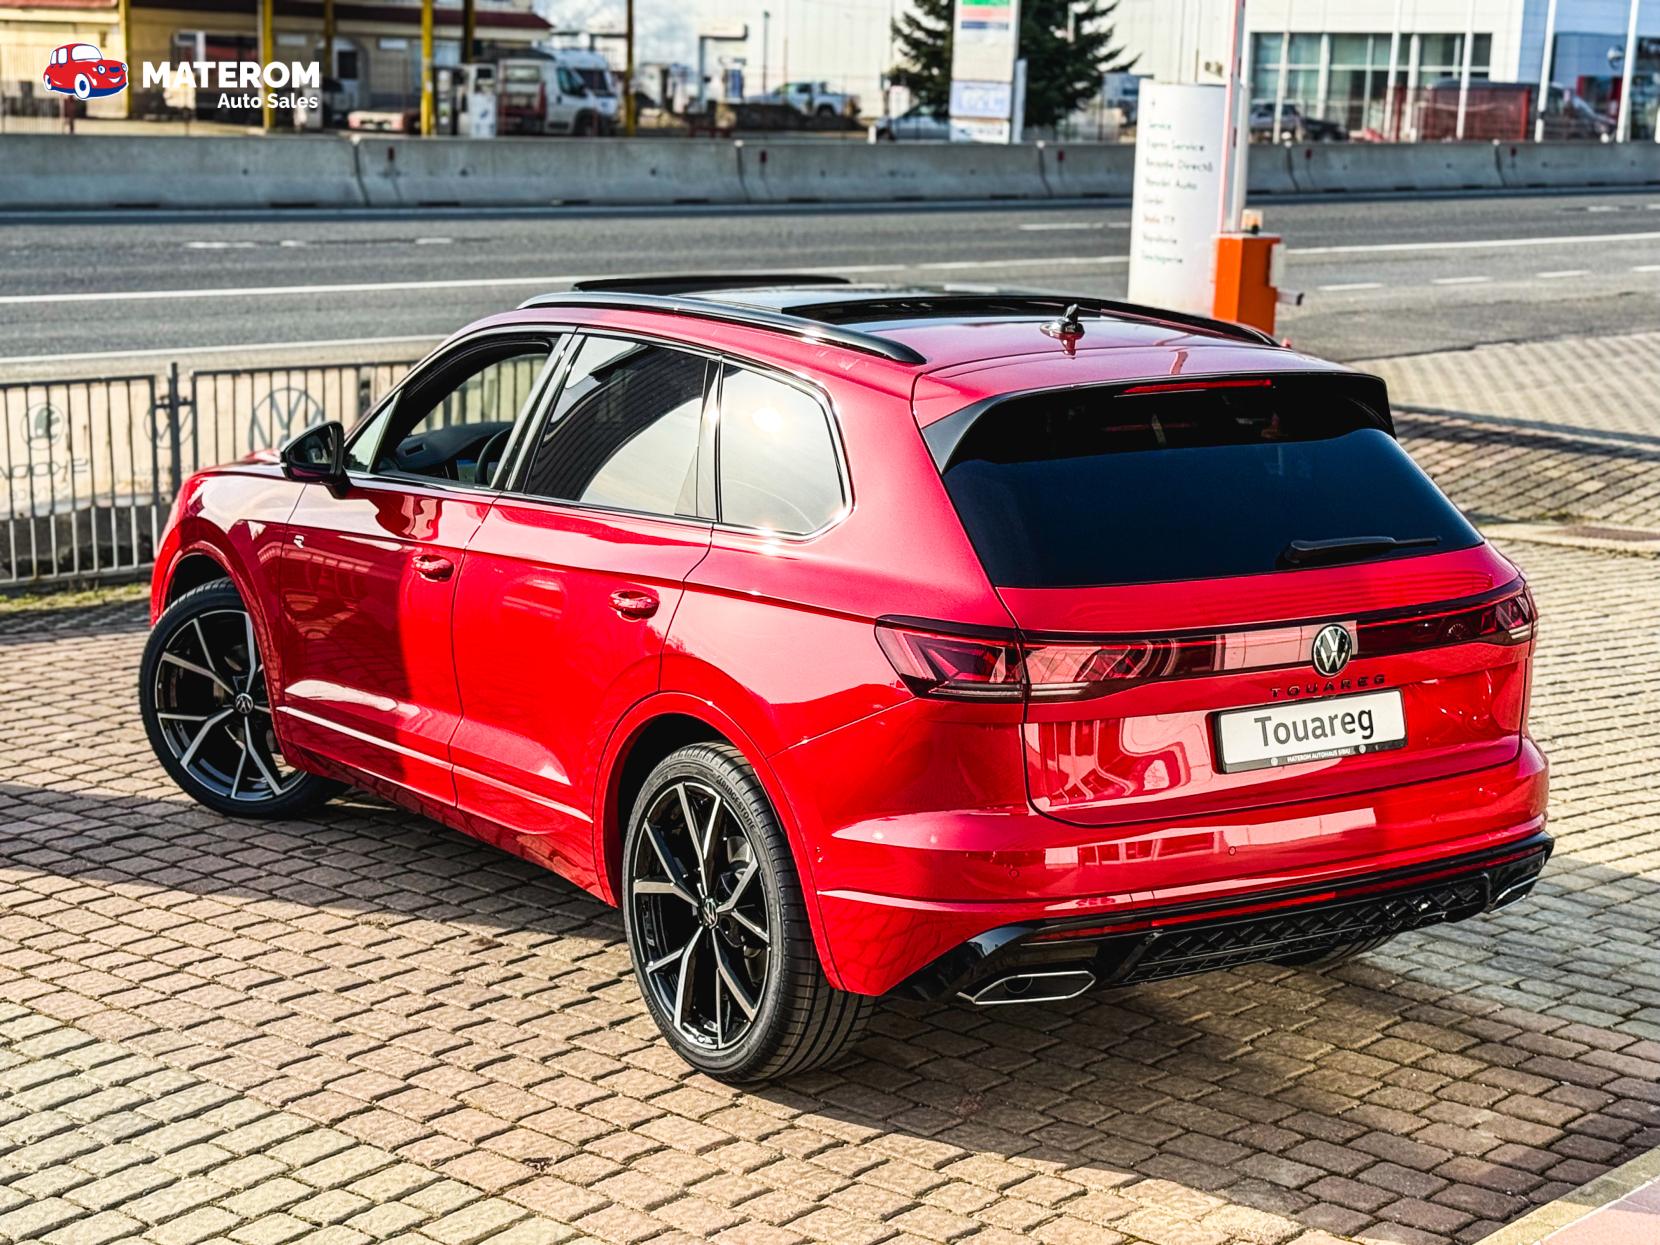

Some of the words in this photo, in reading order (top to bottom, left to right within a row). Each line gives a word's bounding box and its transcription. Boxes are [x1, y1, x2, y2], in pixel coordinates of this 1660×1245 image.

[1271, 674, 1385, 697] TOUAREG
[1254, 709, 1374, 746] Touareg
[715, 774, 756, 832] BRIDGESTONE
